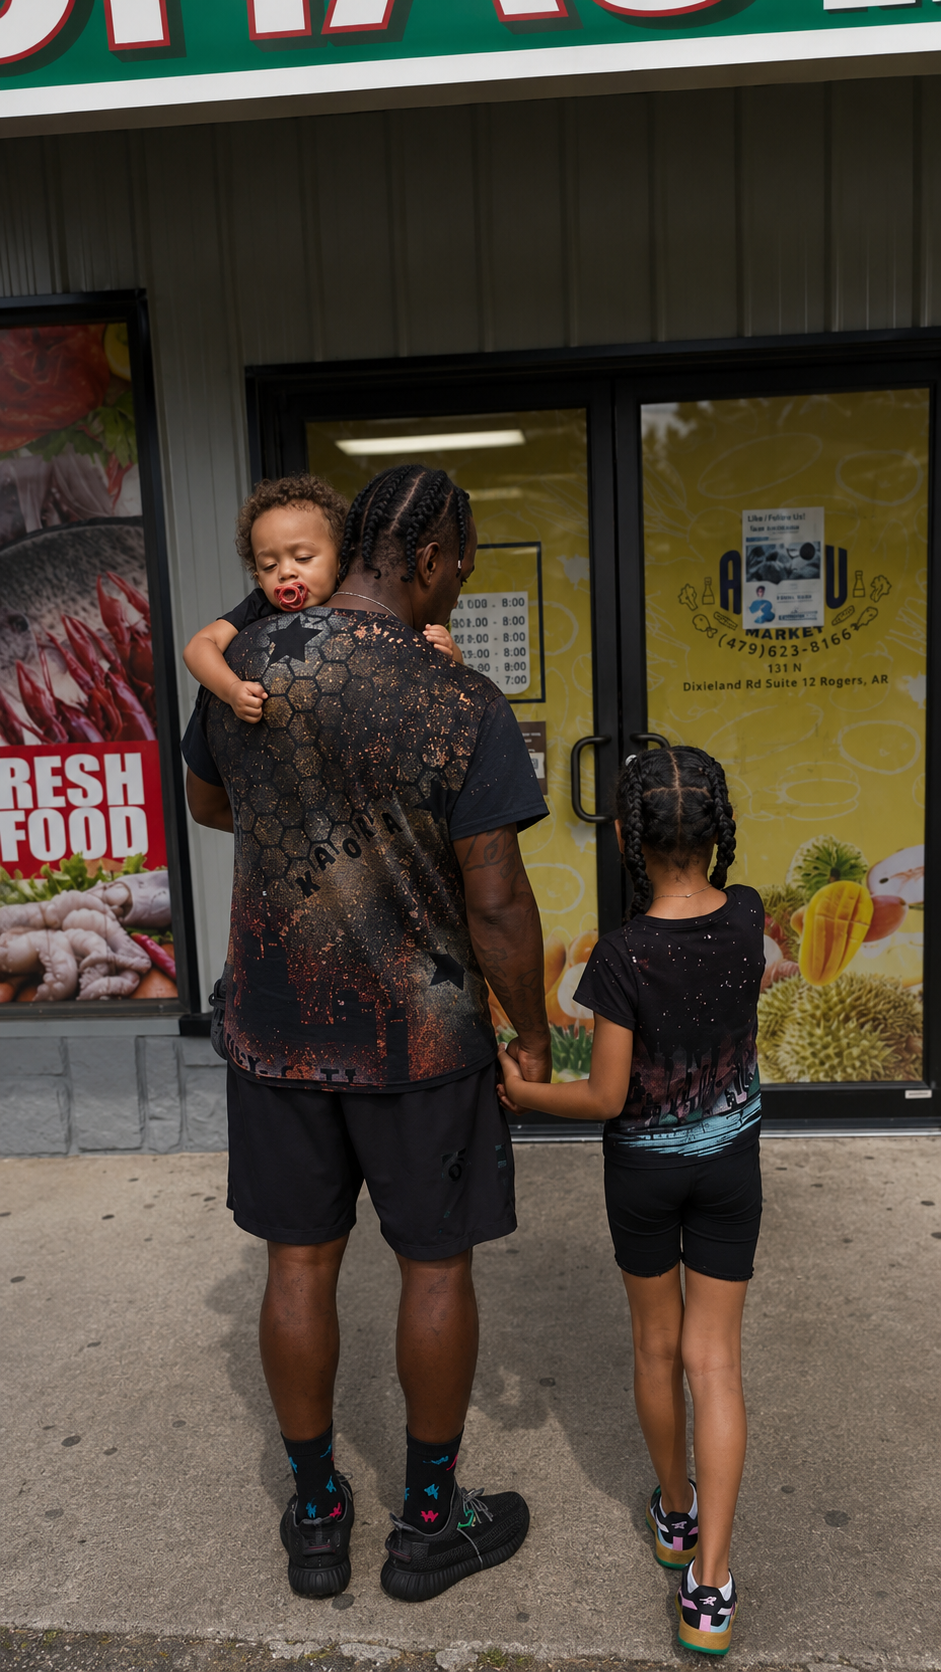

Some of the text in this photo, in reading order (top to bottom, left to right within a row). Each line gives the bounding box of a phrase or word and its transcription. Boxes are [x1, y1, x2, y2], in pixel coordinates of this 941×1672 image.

[745, 626, 824, 640] MARKET
[719, 629, 852, 659] (479)623-8166
[768, 663, 802, 674] 131 N
[683, 674, 889, 692] Dixieland Rd Suite 12 Rogers, AR
[0, 806, 149, 862] FOOD
